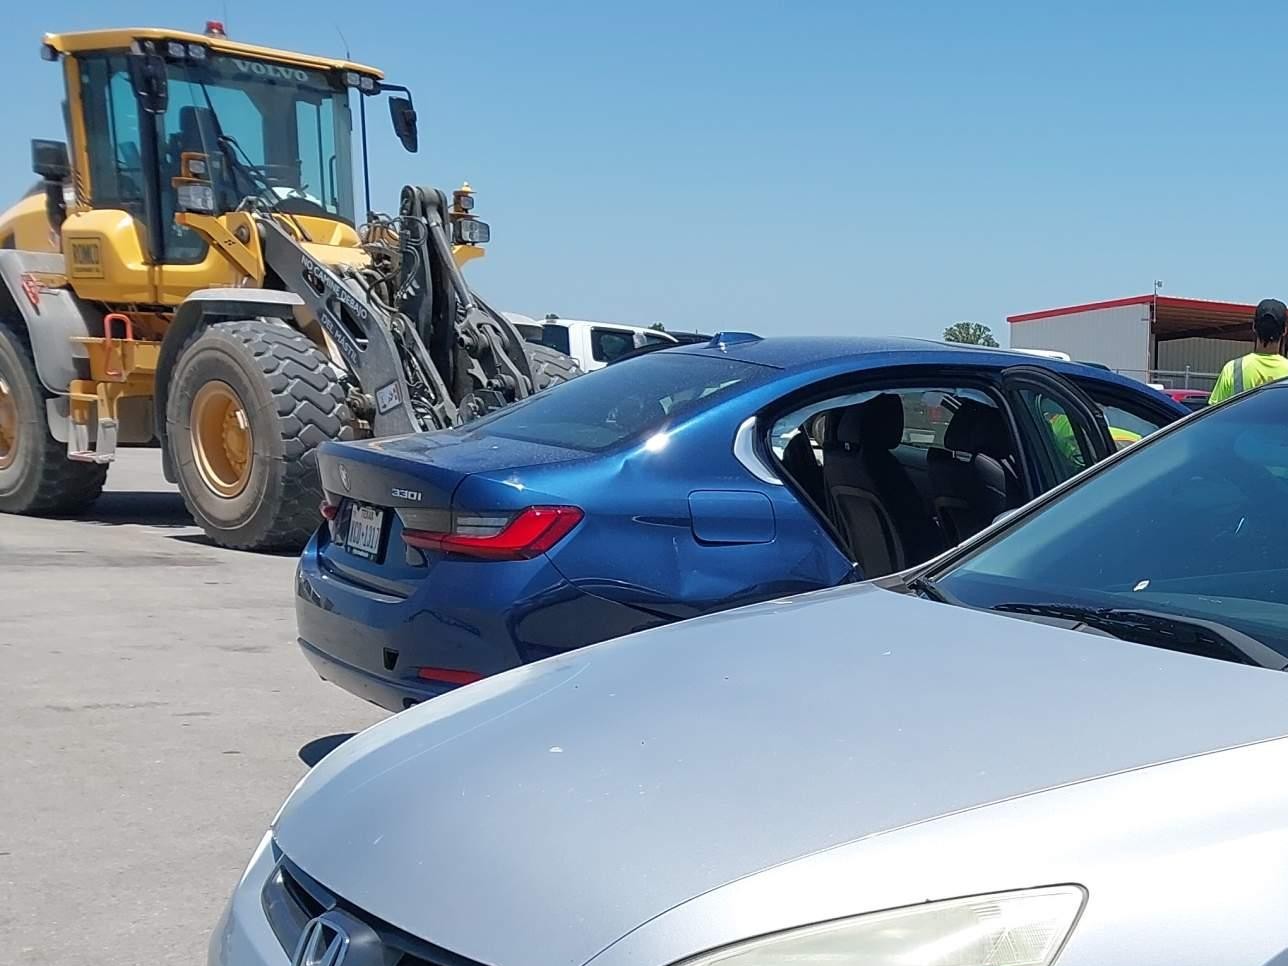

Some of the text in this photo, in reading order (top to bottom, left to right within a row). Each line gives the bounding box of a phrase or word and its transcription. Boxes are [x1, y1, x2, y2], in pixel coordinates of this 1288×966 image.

[232, 59, 309, 81] VOLVO
[301, 255, 368, 319] NO CAMINE DEBAJO
[321, 315, 334, 333] DEL
